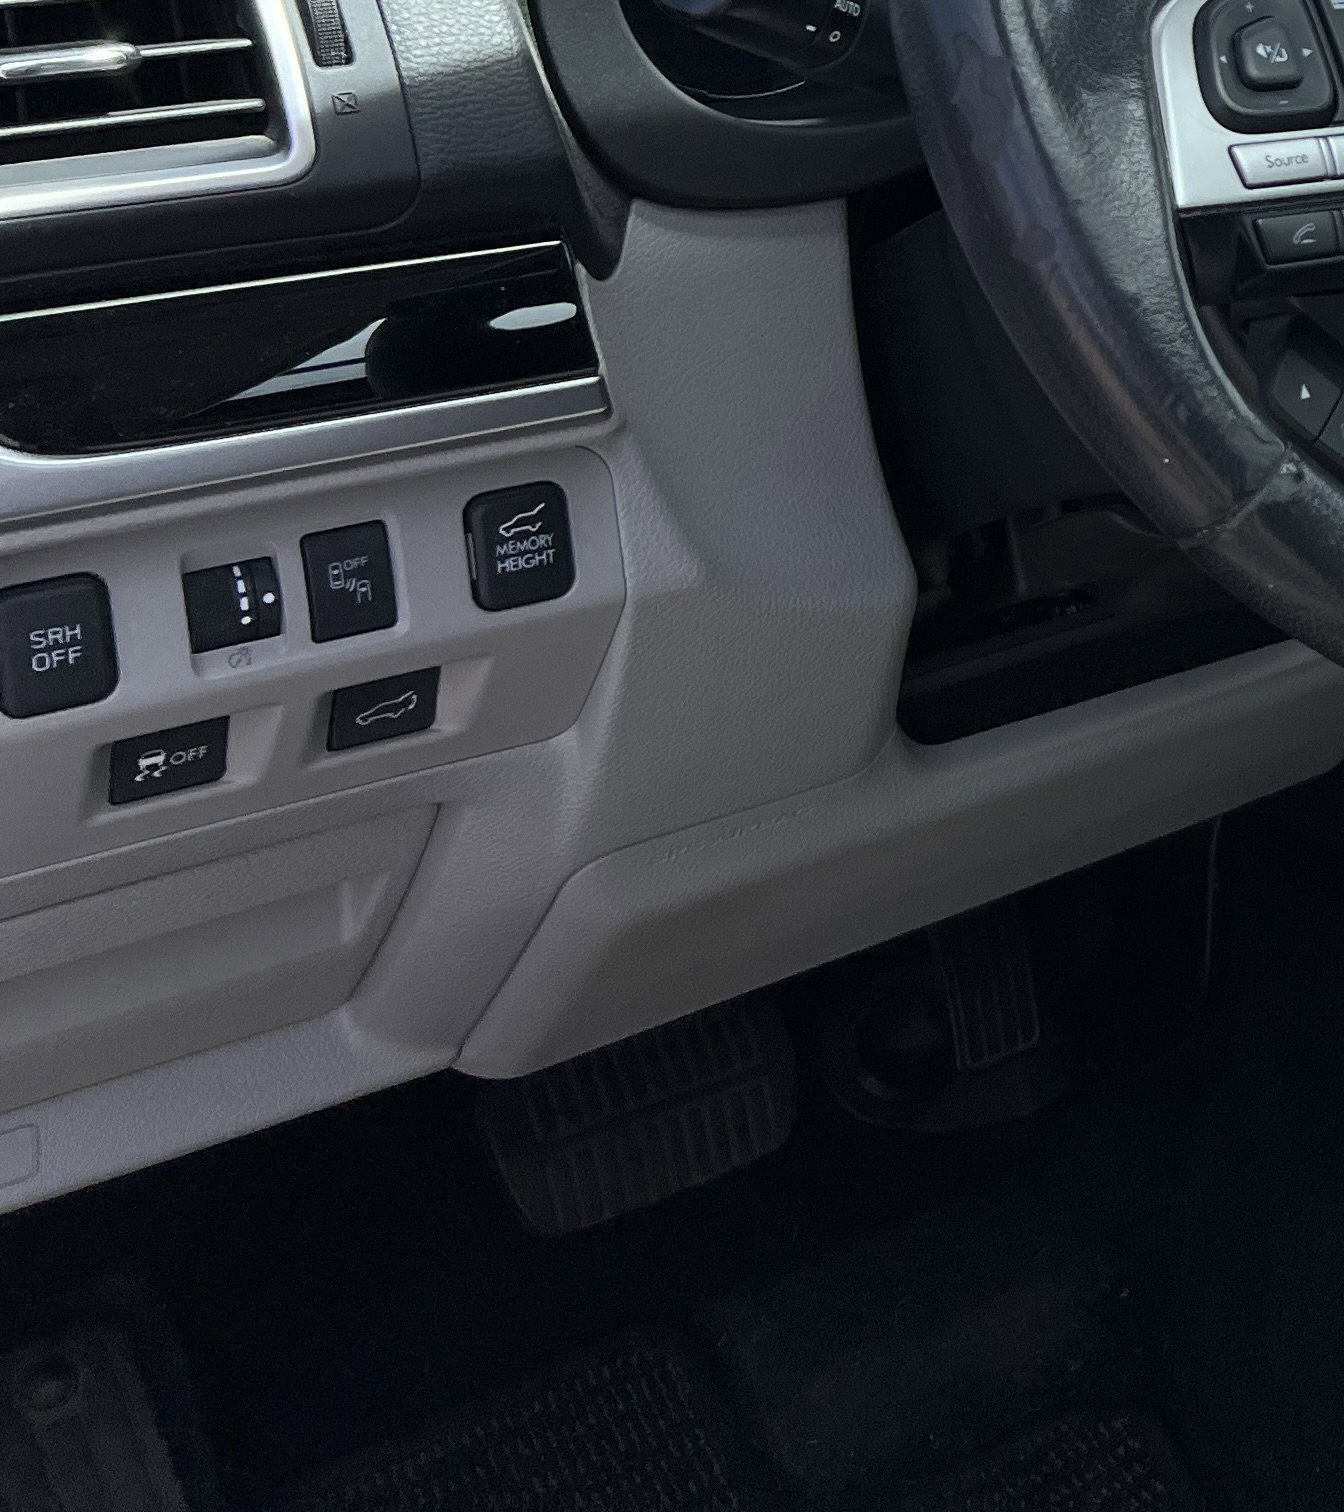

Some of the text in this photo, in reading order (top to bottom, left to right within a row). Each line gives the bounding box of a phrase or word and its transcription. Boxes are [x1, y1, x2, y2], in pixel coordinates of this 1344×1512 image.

[1265, 153, 1309, 169] Source
[495, 533, 555, 557] MEMORY
[343, 555, 369, 571] OFF
[496, 548, 556, 575] HEIGHT
[29, 623, 82, 649] SRH
[31, 645, 83, 672] OFF
[169, 745, 208, 766] OFF
